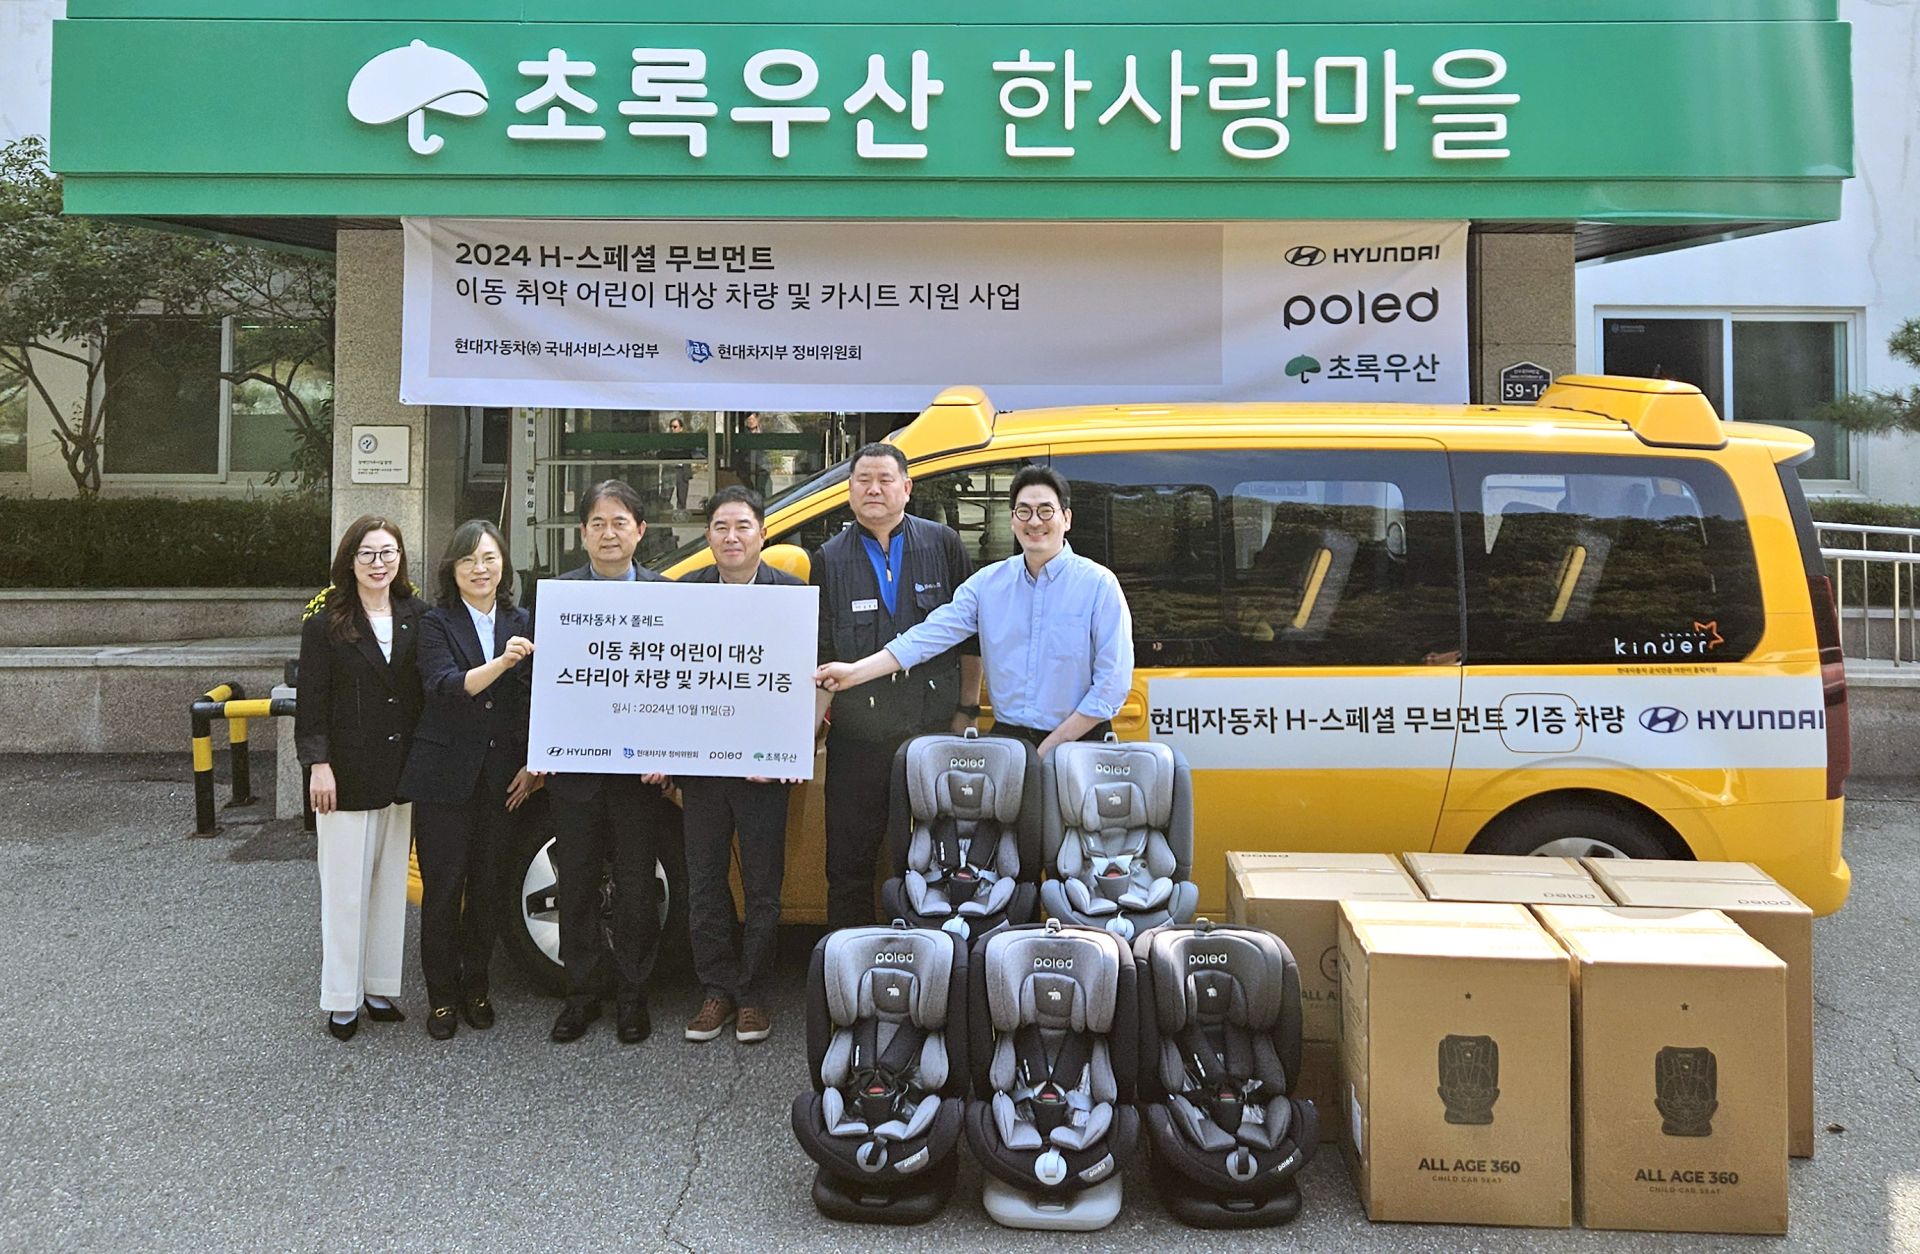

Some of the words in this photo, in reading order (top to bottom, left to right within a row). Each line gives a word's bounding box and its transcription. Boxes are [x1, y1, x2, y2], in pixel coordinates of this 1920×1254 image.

[506, 47, 944, 160] 초록우산
[992, 48, 1521, 161] 한사랑마을
[455, 242, 532, 267] 2024
[540, 244, 656, 273] H-스페셜
[665, 244, 775, 273] 무브먼트
[1333, 244, 1440, 263] HYUNDAI
[456, 276, 507, 306] 이동
[515, 278, 568, 307] 취약
[576, 280, 654, 308] 어린이
[665, 281, 718, 310] 대상
[725, 282, 779, 311] 차량
[788, 282, 811, 311] 및
[820, 282, 900, 310] 카시트
[908, 282, 959, 311] 지원
[968, 282, 1021, 311] 사업
[1283, 286, 1439, 331] poled
[544, 340, 660, 359] 국내서비스사업부
[718, 344, 789, 360] 현대차지부
[792, 344, 863, 361] 정비위원회
[1327, 353, 1440, 383] 초록우산
[559, 612, 616, 627] 현대자동차
[619, 614, 628, 626] X
[630, 614, 664, 628] 폴레드
[588, 641, 624, 661] 이동
[629, 641, 665, 662] 취약
[670, 643, 723, 663] 어린이
[728, 644, 765, 665] 대상
[1614, 637, 1707, 655] kinder
[556, 668, 630, 688] 스타리아
[634, 669, 671, 689] 차량
[676, 670, 693, 690] 및
[698, 671, 752, 691] 카시트
[756, 672, 793, 693] 기증
[612, 702, 631, 714] 일시
[639, 703, 675, 715] 2024년
[677, 704, 698, 715] 10월
[701, 704, 735, 717] 11일(금)
[1150, 706, 1278, 736] 현대자동차
[1286, 706, 1396, 734] H-스페셜
[1404, 706, 1508, 734] 무브먼트
[1515, 705, 1567, 734] 기증
[1575, 705, 1625, 734] 차량
[1697, 709, 1825, 730] HYUNDAI
[566, 748, 612, 756] HYUNDAI
[709, 751, 743, 760] poled
[765, 752, 797, 763] 초록우산
[950, 757, 985, 769] poled
[1095, 763, 1131, 776] poled
[875, 952, 914, 964] poled
[1033, 957, 1074, 969] poled
[1189, 953, 1228, 966] poled
[1418, 1158, 1450, 1171] ALL
[1453, 1159, 1487, 1173] AGE
[1490, 1160, 1521, 1174] 360
[1635, 1168, 1667, 1182] ALL
[1671, 1170, 1705, 1184] AGE
[1708, 1171, 1739, 1185] 360
